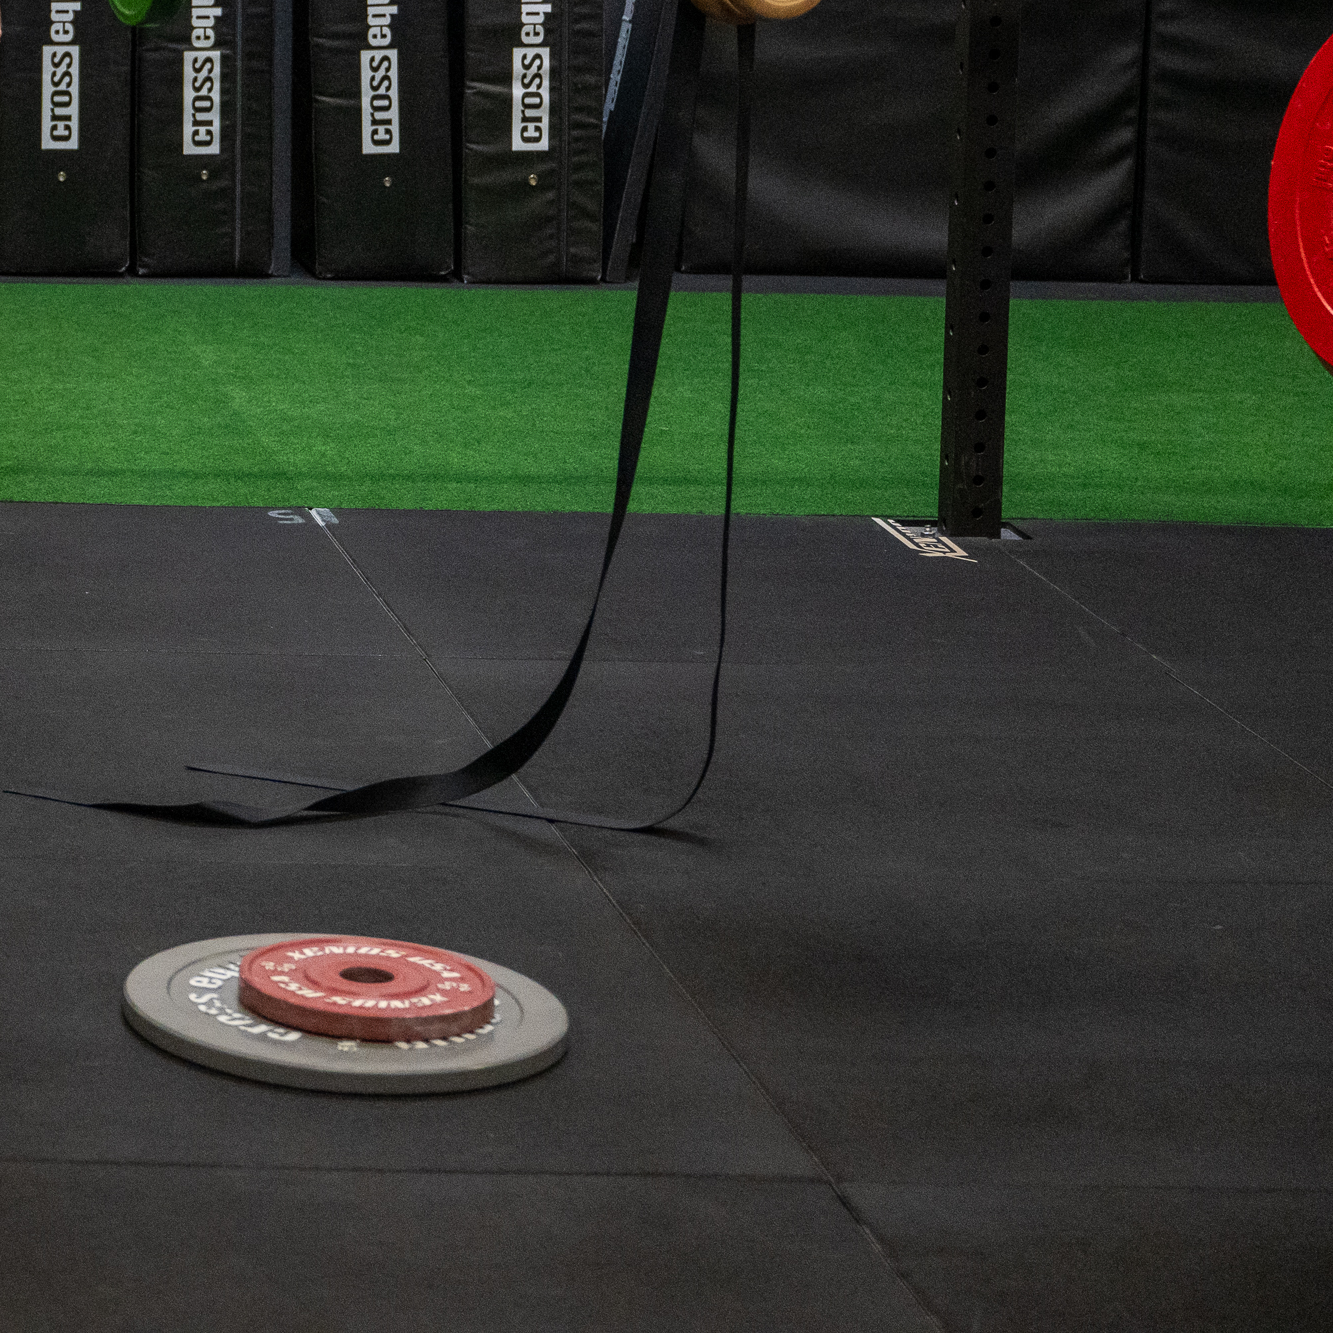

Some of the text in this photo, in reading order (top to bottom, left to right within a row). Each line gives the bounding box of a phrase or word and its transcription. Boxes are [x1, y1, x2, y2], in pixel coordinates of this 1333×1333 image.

[48, 50, 74, 144] cross
[190, 55, 215, 149] cross
[369, 54, 393, 148] cross
[519, 52, 544, 145] cross
[268, 974, 328, 999] USA
[285, 945, 463, 979] XENIOS USA
[323, 992, 451, 1010] XENIOS
